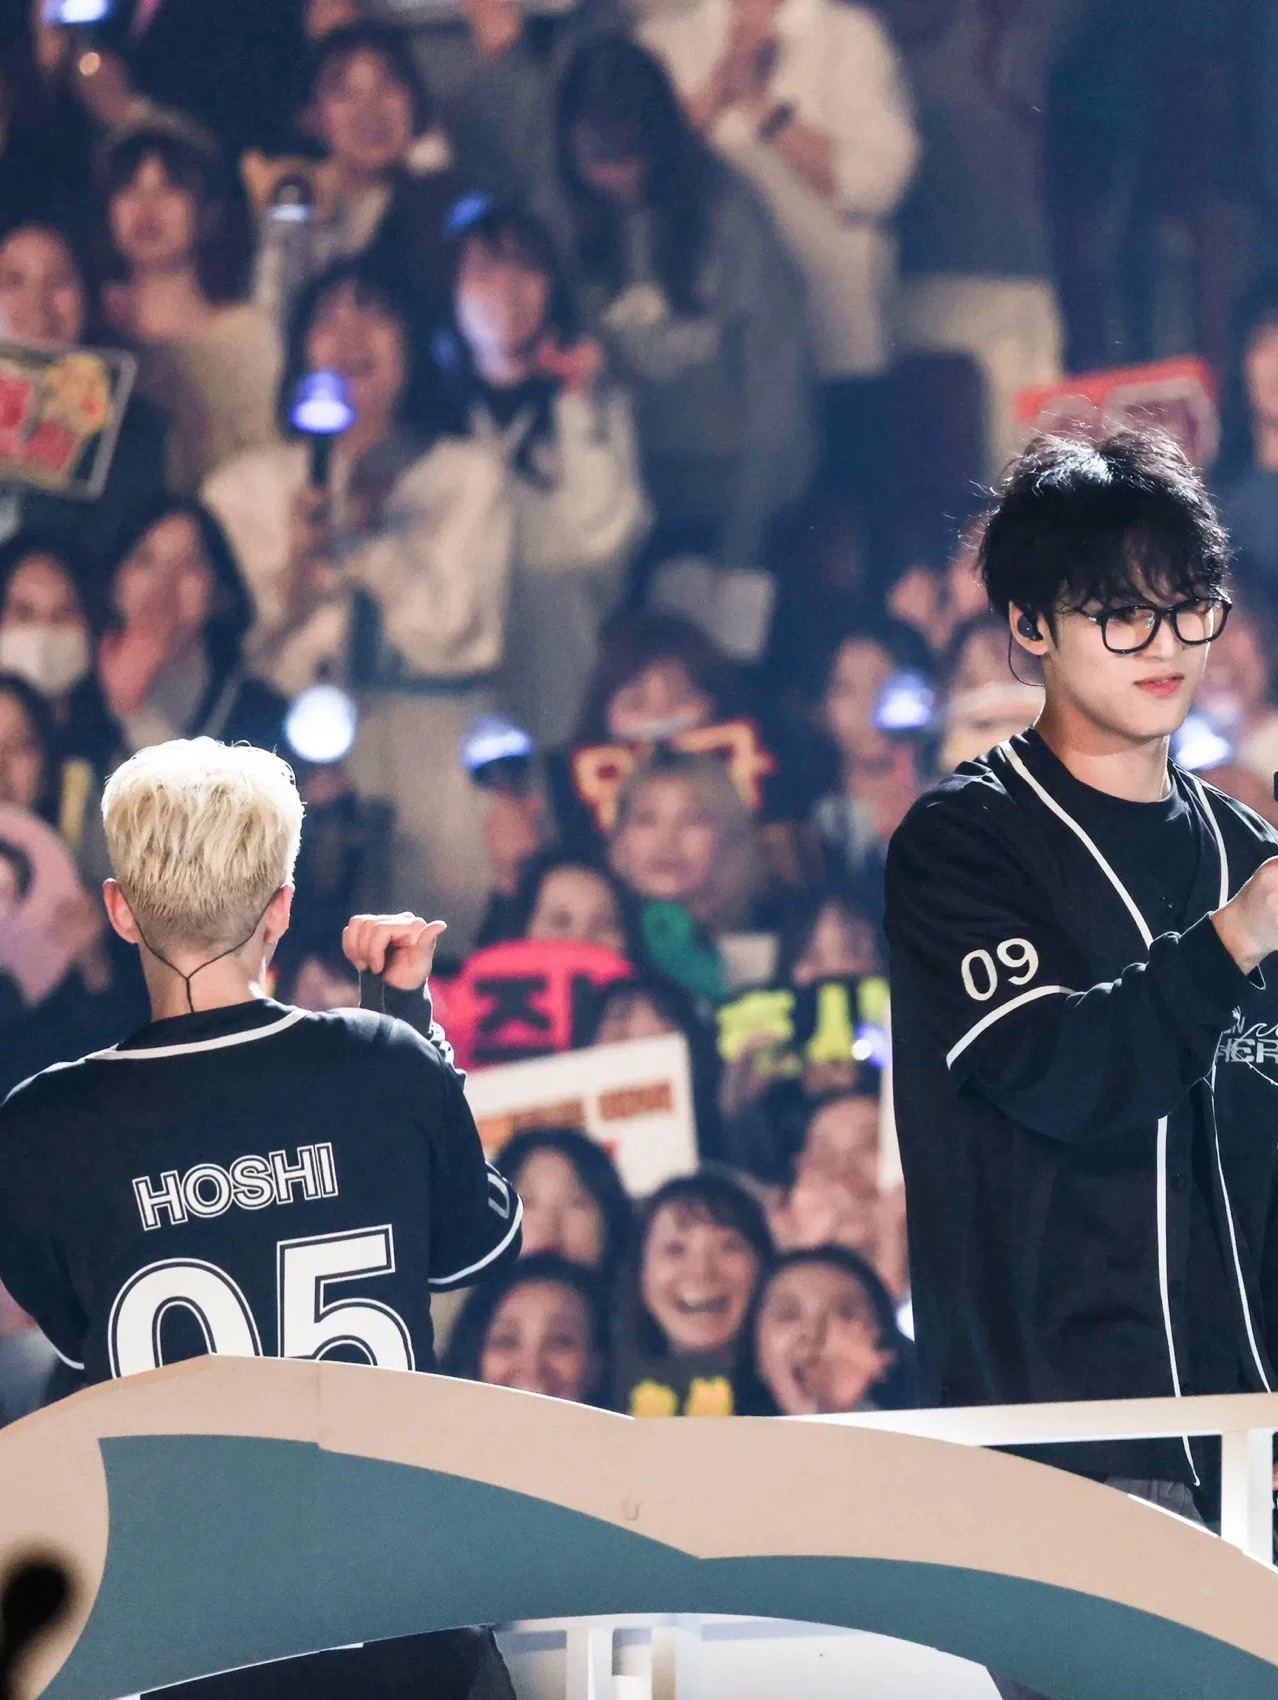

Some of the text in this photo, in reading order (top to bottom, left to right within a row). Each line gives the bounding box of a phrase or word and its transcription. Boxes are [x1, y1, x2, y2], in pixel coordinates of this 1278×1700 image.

[961, 937, 1039, 1001] 09
[132, 1142, 338, 1231] HOSHI
[107, 1224, 416, 1379] 05
